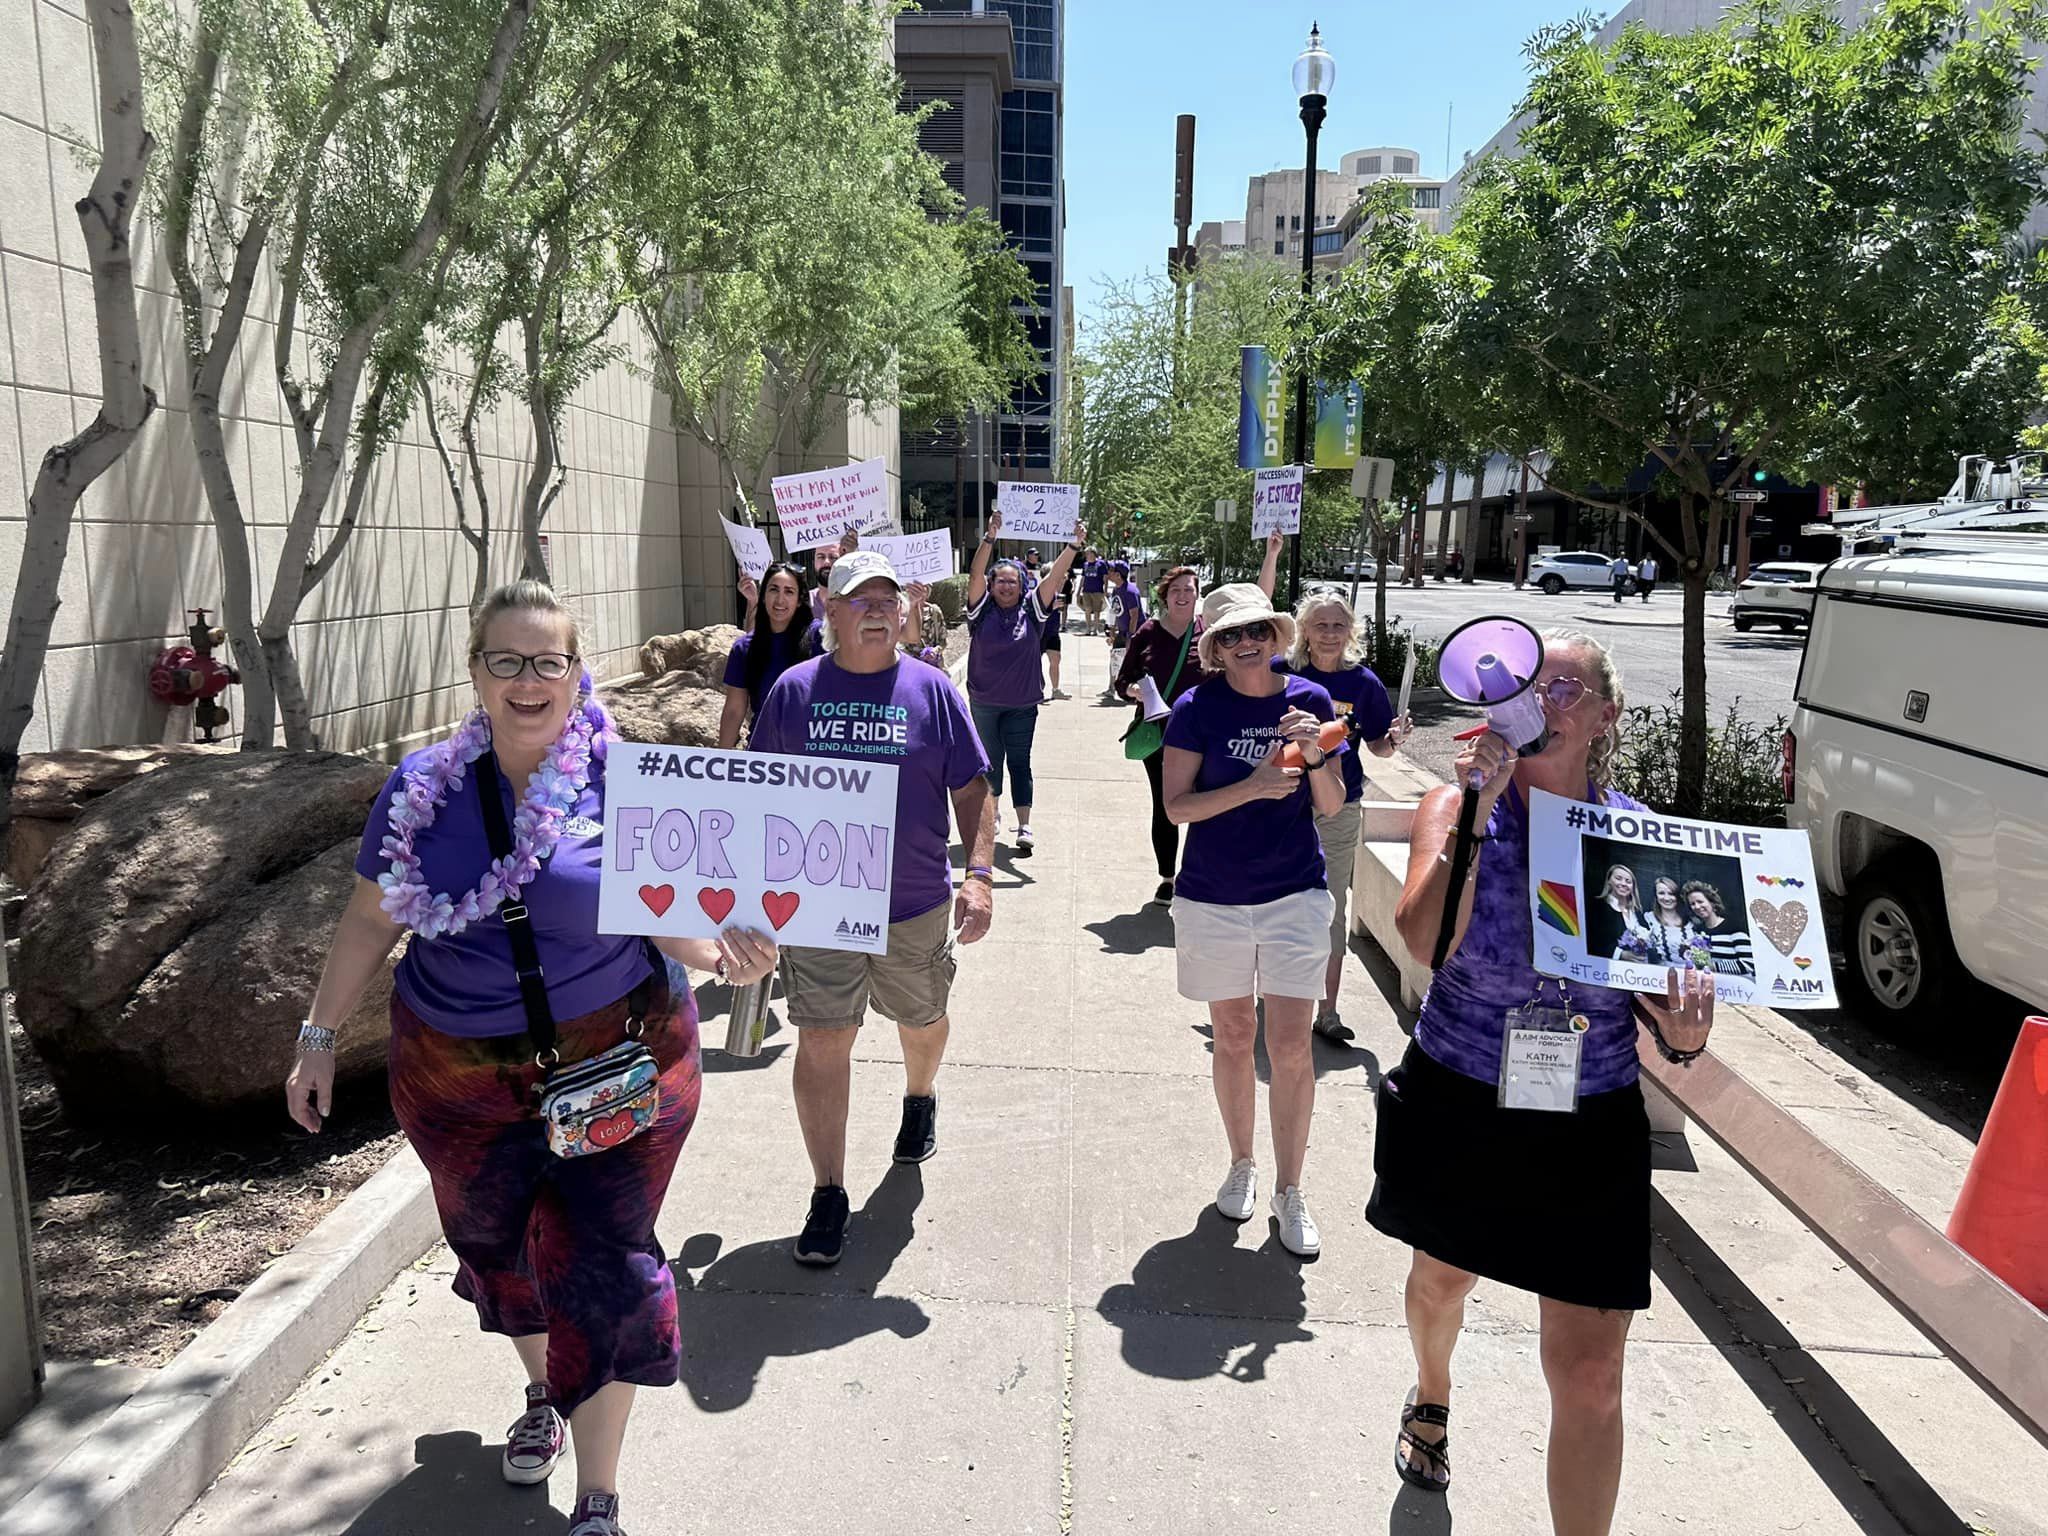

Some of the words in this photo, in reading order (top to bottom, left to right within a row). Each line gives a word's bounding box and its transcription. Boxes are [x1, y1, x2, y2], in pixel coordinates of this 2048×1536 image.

[1264, 359, 1281, 456] DTPHX
[1257, 469, 1297, 480] #ACCESSNOW
[774, 483, 803, 500] THEY
[808, 478, 835, 496] MAY
[841, 472, 861, 488] NOT
[844, 493, 857, 502] WE
[860, 486, 879, 498] WILL
[1011, 484, 1068, 495] #MORETIME
[1268, 482, 1301, 504] ESTHER
[1034, 498, 1046, 515] 2
[780, 517, 809, 529] NEVER
[796, 524, 839, 545] ACCESS
[843, 509, 874, 532] NOW!
[904, 536, 941, 555] MORE
[892, 557, 941, 575] ITING
[811, 702, 908, 721] TOGETHER
[808, 719, 846, 740] WE
[852, 721, 907, 744] RIDE
[1241, 727, 1282, 738] MEMORIE
[804, 742, 817, 751] TO
[818, 742, 840, 752] END
[841, 744, 908, 756] ALZHEIMER'S.
[638, 752, 872, 793] #ACCESSNOW
[1566, 806, 1763, 855] #MORETIME
[615, 807, 737, 879] FOR
[764, 814, 889, 892] DON
[851, 922, 880, 938] AIM
[1570, 962, 1667, 990] #TeamGrace
[1717, 984, 1753, 1002] gnity
[1790, 979, 1824, 993] AIM
[1540, 1034, 1577, 1043] ADVOCACY
[1526, 1052, 1559, 1062] KATHY
[600, 1121, 627, 1139] LOVE
